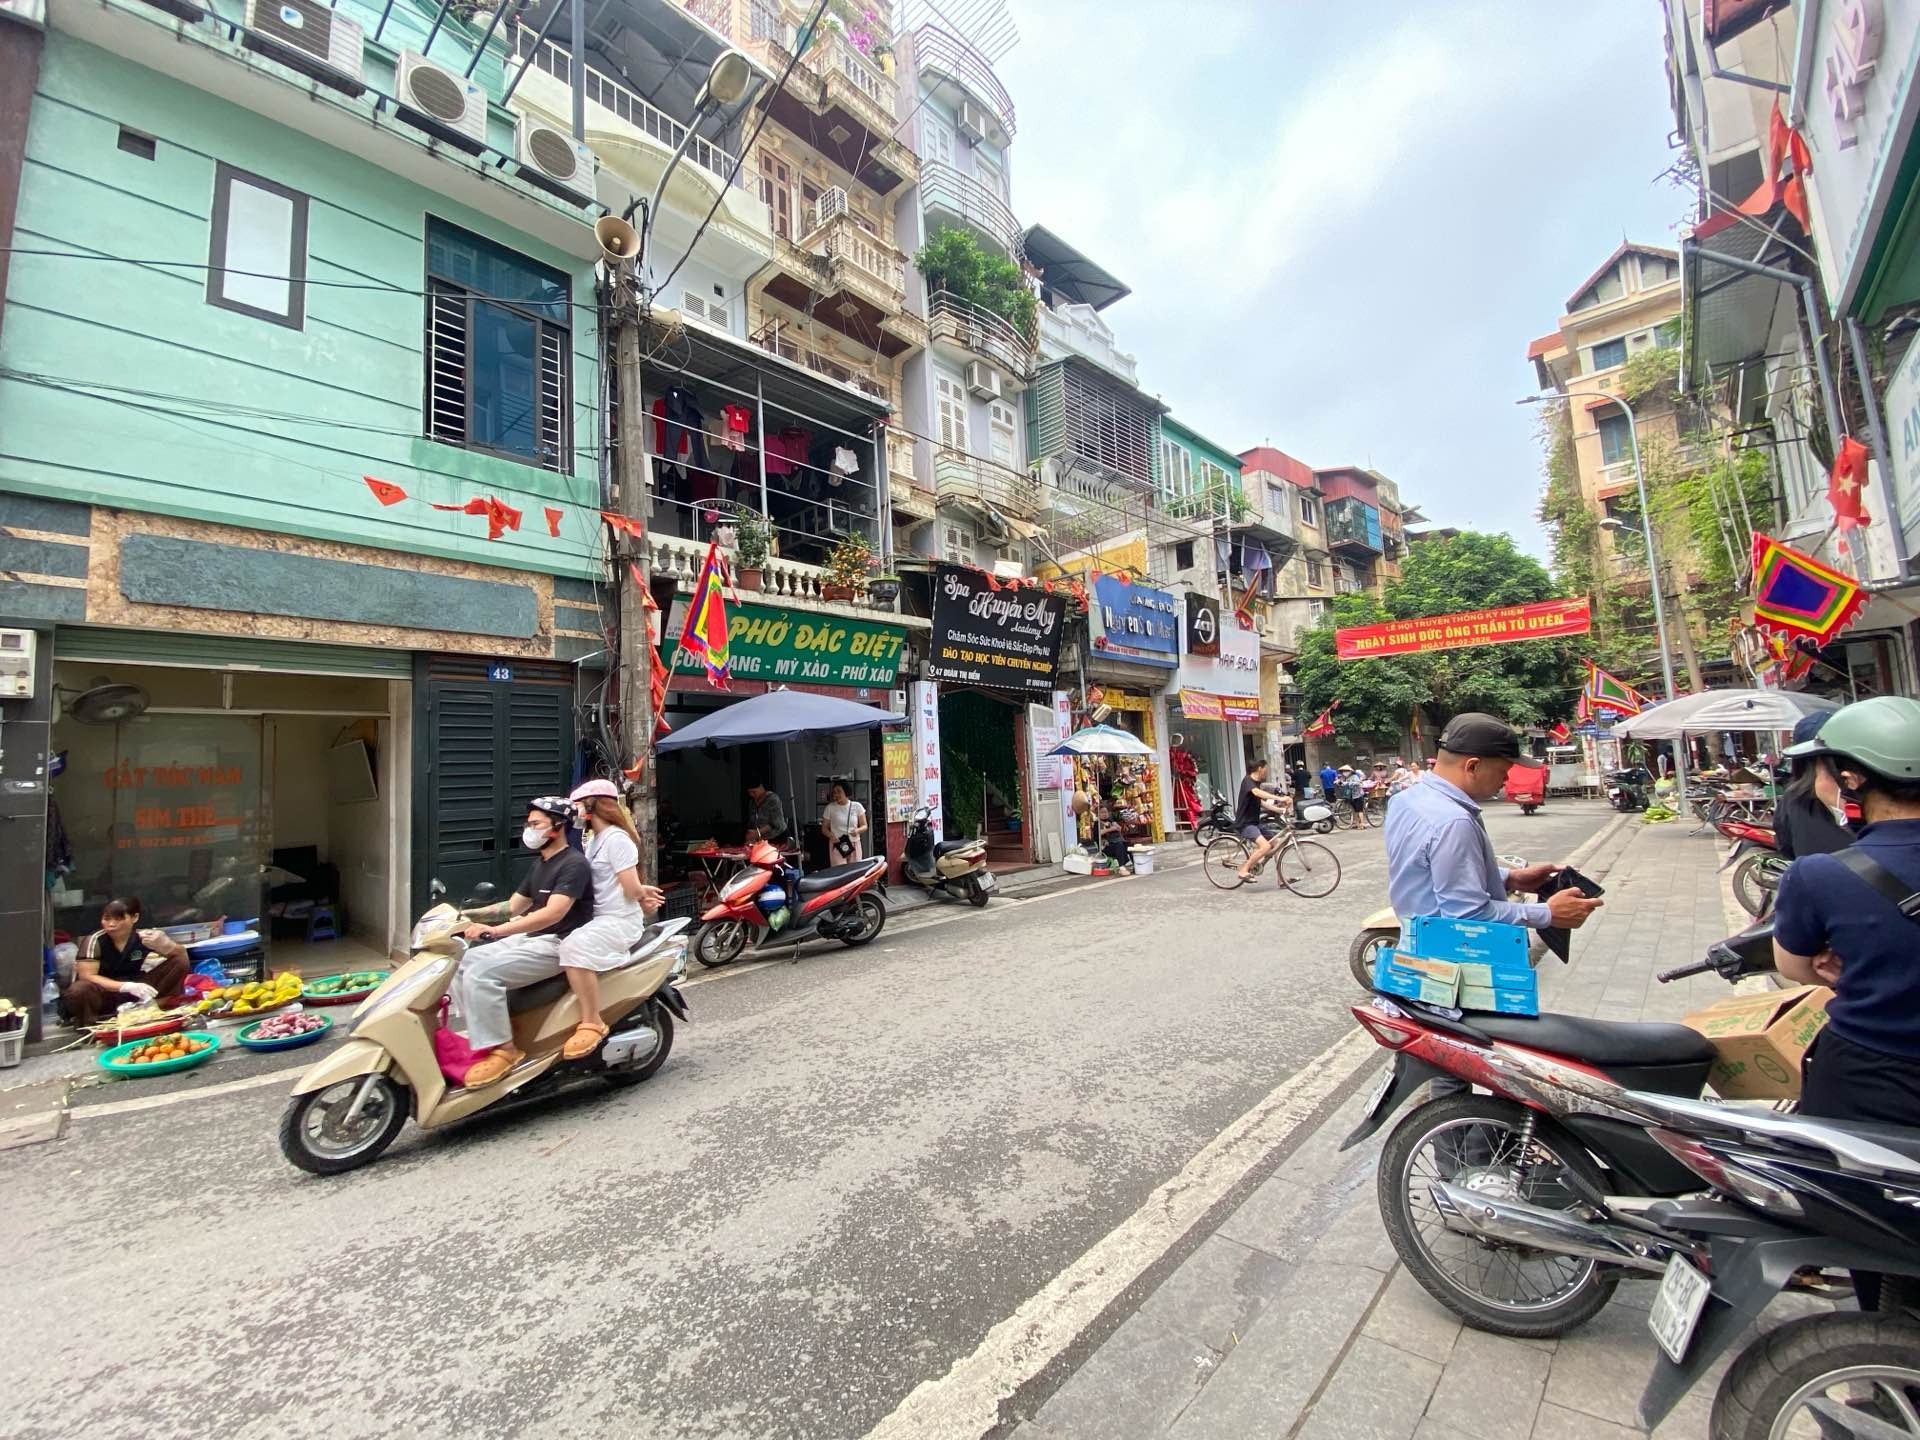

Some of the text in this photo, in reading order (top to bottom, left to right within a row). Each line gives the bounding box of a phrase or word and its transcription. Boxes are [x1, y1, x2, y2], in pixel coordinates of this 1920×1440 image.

[944, 574, 970, 600] Spa
[729, 612, 903, 662] PHỞ ĐẶC BIỆT
[1010, 622, 1042, 640] Academy
[1356, 634, 1386, 650] NGÀY
[1388, 632, 1417, 646] SINH
[1419, 628, 1442, 642] ĐỨC
[1445, 622, 1470, 639] ÔNG
[1509, 617, 1526, 631] TÚ
[800, 654, 830, 678] XÀO
[840, 661, 867, 681] PHỞ
[868, 663, 894, 683] XÀO
[961, 650, 974, 663] TẠO
[975, 653, 990, 665] HỌC
[493, 667, 509, 680] 43
